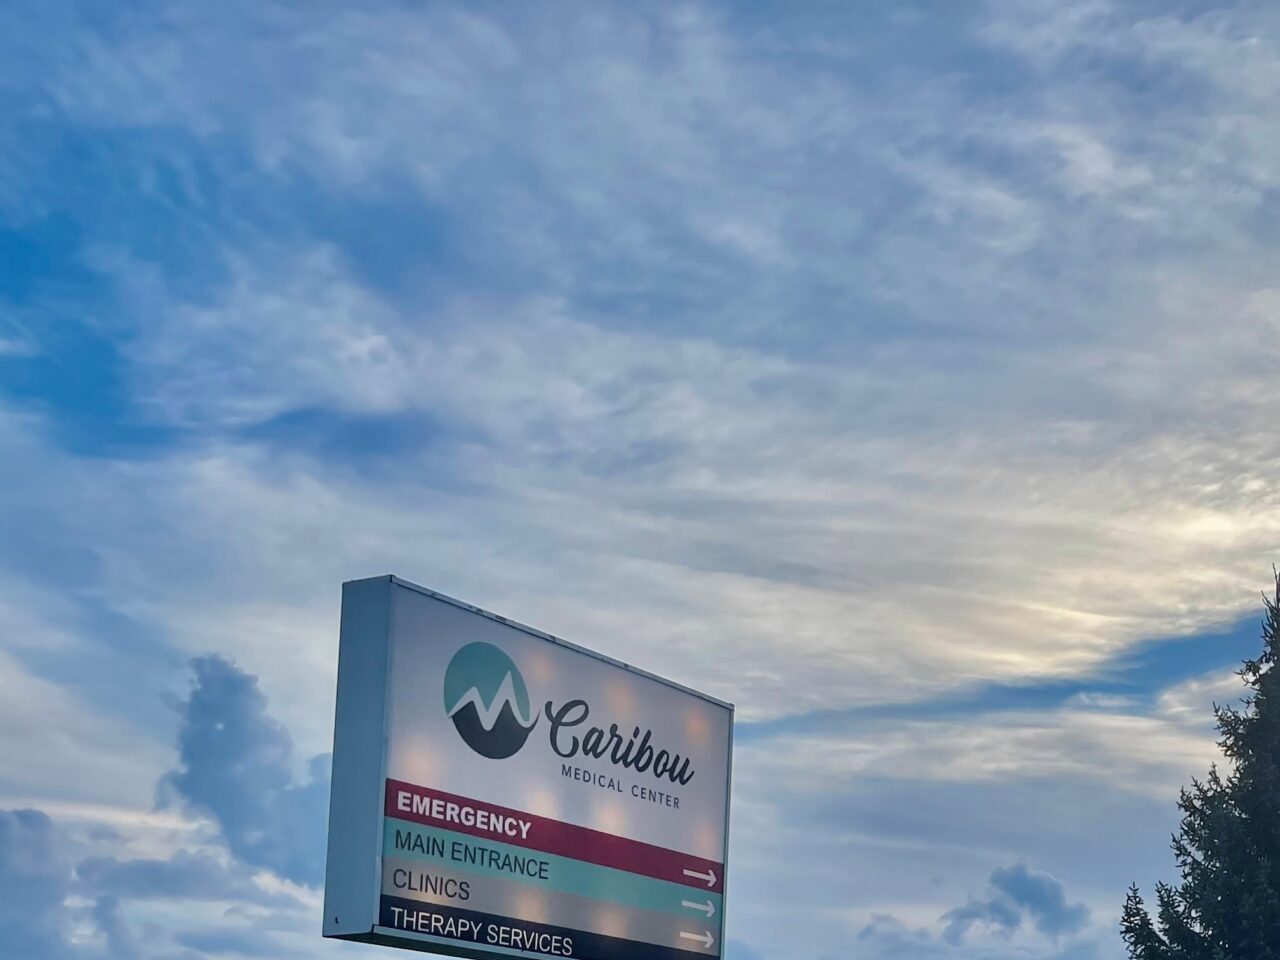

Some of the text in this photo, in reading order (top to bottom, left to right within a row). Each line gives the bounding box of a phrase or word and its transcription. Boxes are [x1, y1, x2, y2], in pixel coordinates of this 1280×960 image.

[545, 699, 695, 786] Caribou
[561, 764, 680, 809] MEDICAL CENTER
[397, 790, 532, 839] EMERGENCY
[395, 829, 549, 880] MAIN ENTRANCE
[393, 868, 470, 900] CLINICS
[390, 906, 573, 956] THERAPY SERVICES
